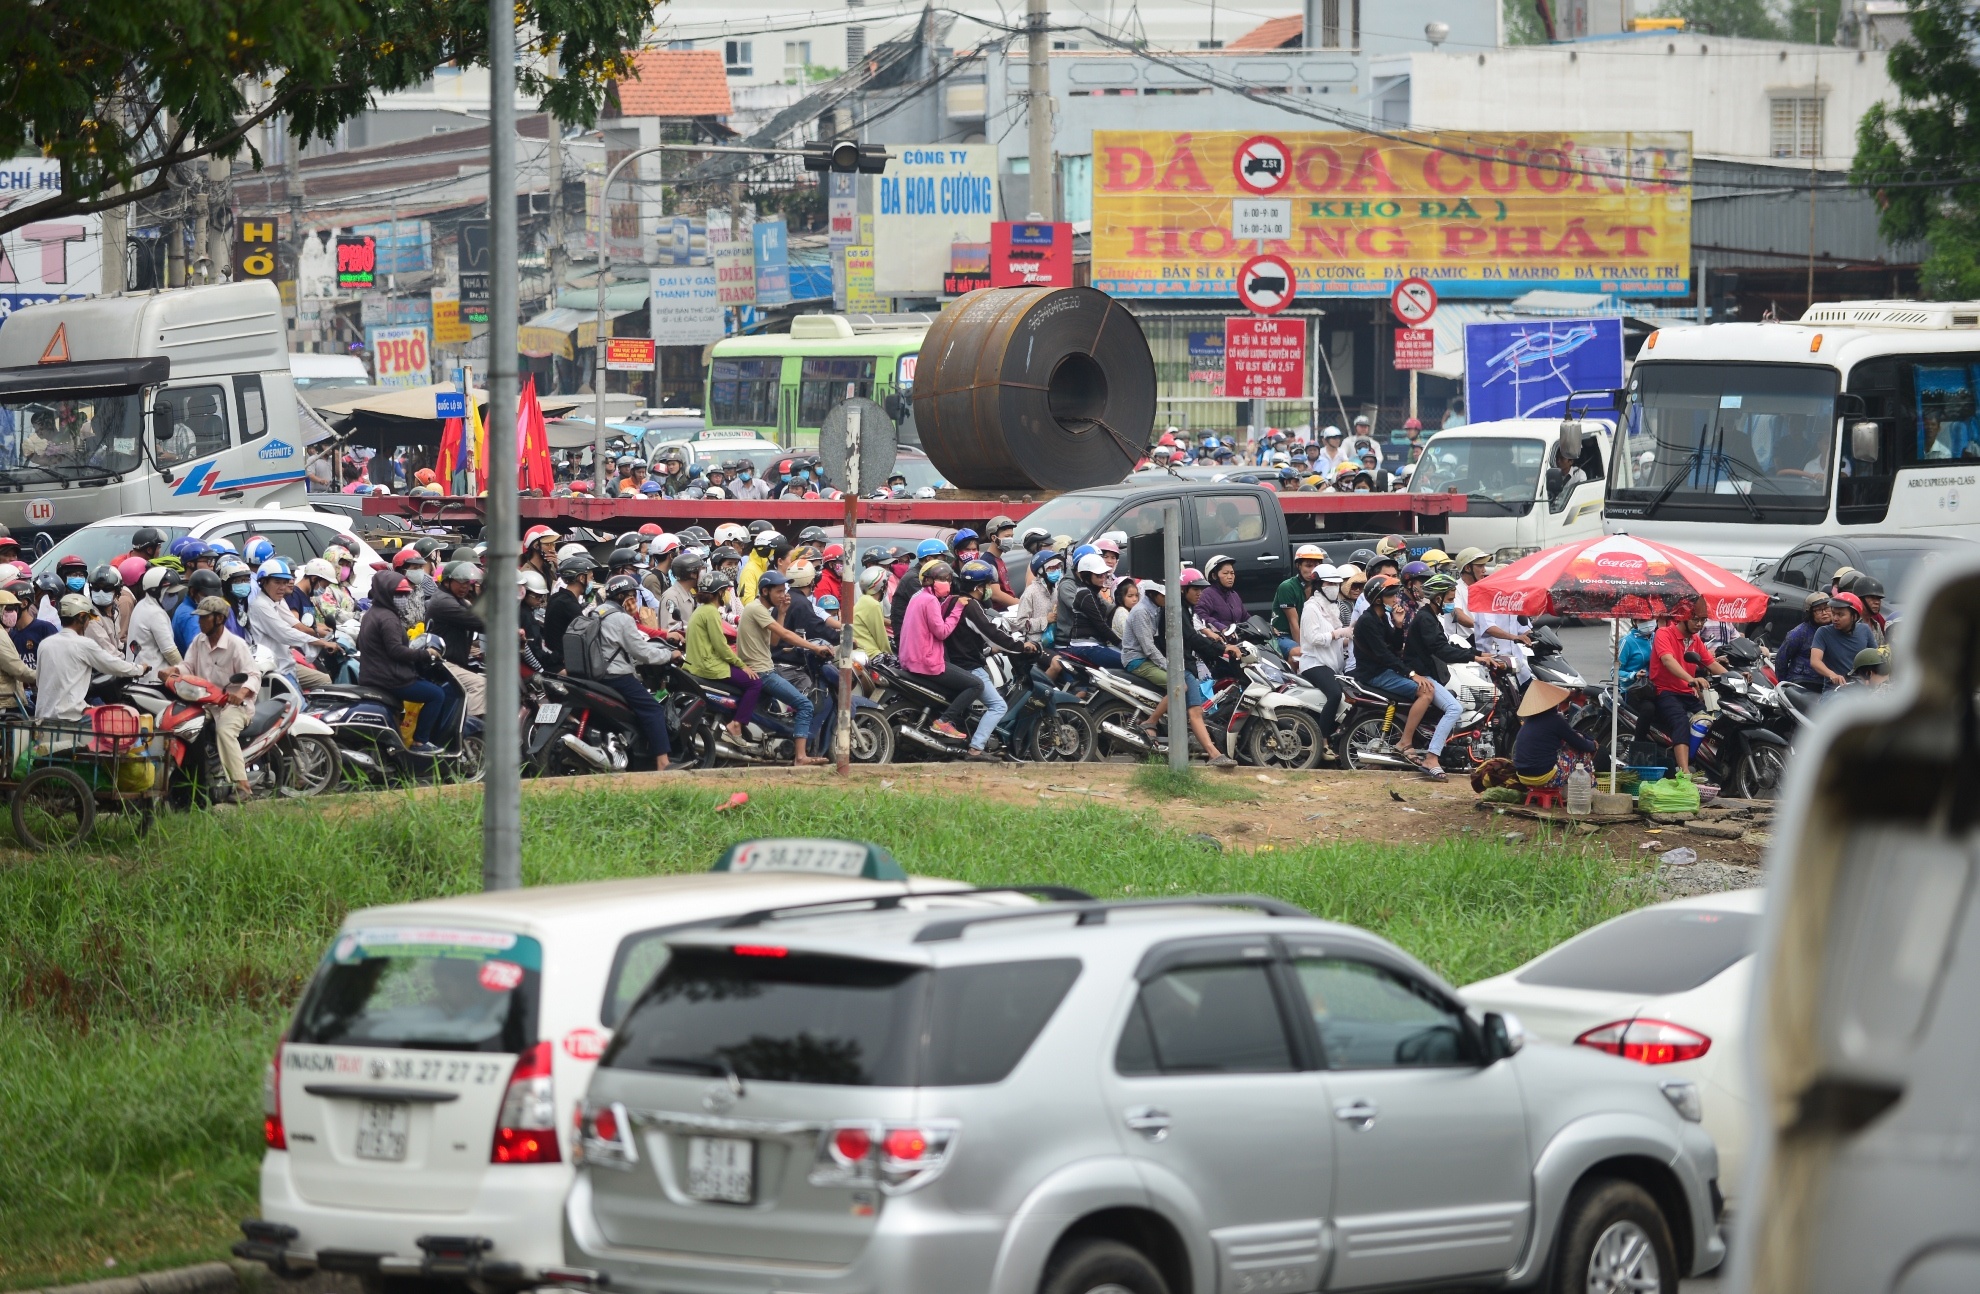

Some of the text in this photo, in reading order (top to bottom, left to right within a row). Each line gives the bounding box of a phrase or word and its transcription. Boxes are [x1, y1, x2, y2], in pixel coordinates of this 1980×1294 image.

[904, 149, 967, 164] CÔNG TY
[1104, 134, 1214, 192] ĐÁ
[1233, 145, 1401, 192] OA
[880, 172, 901, 214] ĐÁ
[906, 177, 936, 214] HOA
[941, 172, 992, 214] CƯƠNG
[1308, 202, 1402, 219] KHO
[1440, 218, 1657, 258] PHÁT
[1215, 268, 1224, 278] &
[1409, 267, 1468, 279] GRAMIC
[1508, 267, 1560, 279] MARBO
[1600, 267, 1649, 279] TRANG
[1254, 319, 1277, 333] CẤM
[376, 329, 426, 374] PHỞ
[260, 447, 291, 459] OVERNITE
[1924, 477, 1948, 487] EXPRESS
[1948, 476, 1976, 486] HI-CLASS
[32, 502, 51, 518] LH
